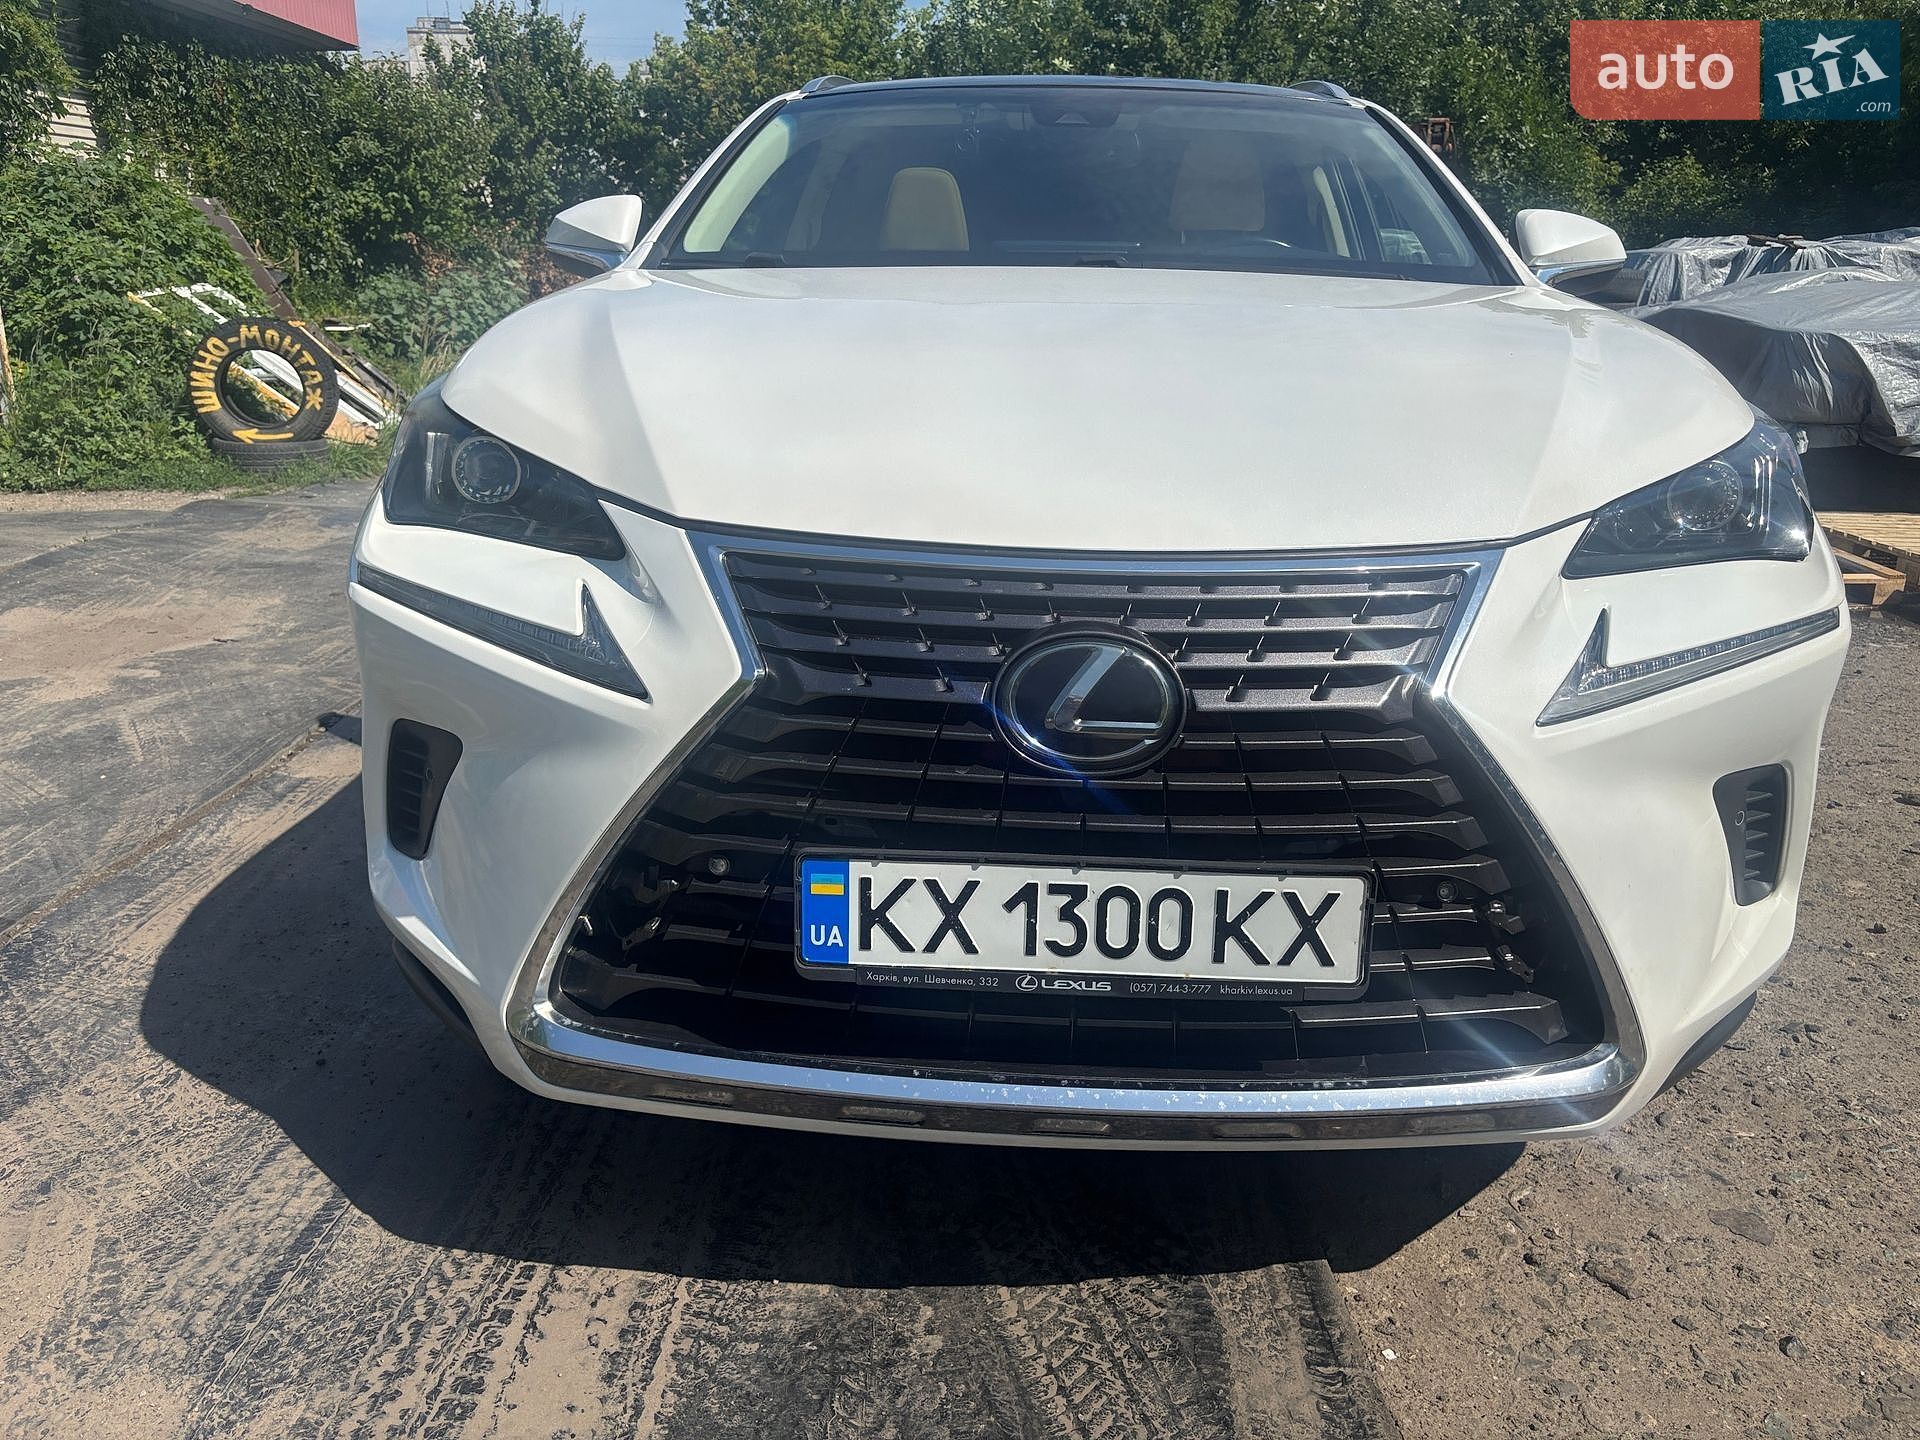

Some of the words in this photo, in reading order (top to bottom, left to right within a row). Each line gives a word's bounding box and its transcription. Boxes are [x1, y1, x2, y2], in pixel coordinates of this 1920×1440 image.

[1002, 882, 1194, 962] 1300
[811, 925, 844, 947] UA
[866, 971, 900, 983] Харків,
[903, 975, 922, 985] вул.
[979, 977, 999, 987] 332
[1041, 979, 1112, 991] LEXUS
[1130, 982, 1157, 994] (057)
[1220, 985, 1293, 996] kharkiv.lexus.ua
